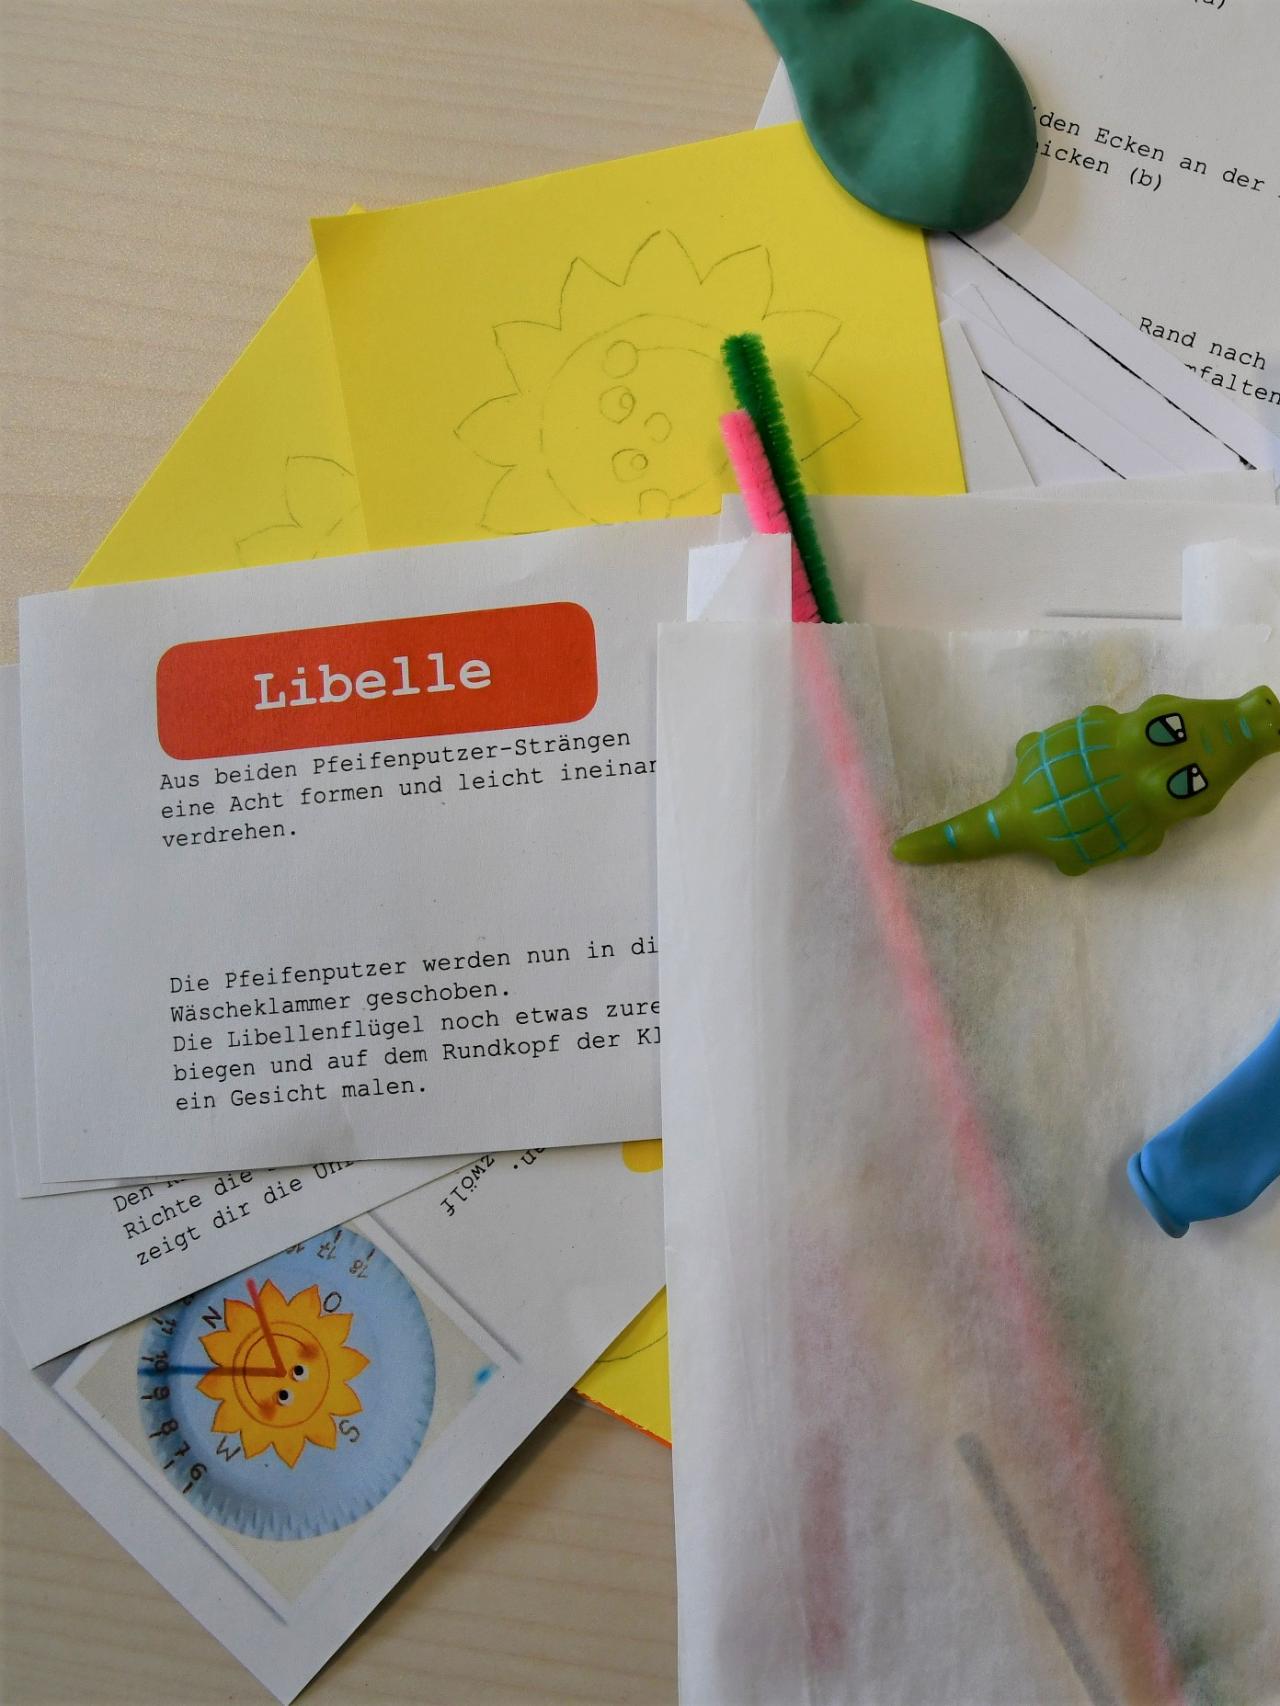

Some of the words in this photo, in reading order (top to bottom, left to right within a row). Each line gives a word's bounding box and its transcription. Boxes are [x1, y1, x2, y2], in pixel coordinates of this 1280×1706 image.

[1094, 128, 1164, 161] Ecken
[1180, 158, 1207, 175] an
[1223, 168, 1265, 191] der
[1130, 168, 1161, 191] (b)
[1139, 317, 1196, 348] Rand
[1209, 343, 1265, 370] nach
[254, 652, 491, 710] Libelle
[160, 774, 199, 790] Aus
[215, 763, 297, 784] beiden
[313, 733, 630, 774] Pfeifenputzer-Strängen
[162, 800, 214, 818] eine
[230, 792, 283, 812] Acht
[301, 786, 383, 805] formen
[399, 776, 442, 795] und
[459, 768, 543, 790] leicht
[162, 823, 295, 847] verdrehen.
[170, 974, 209, 993] Die
[225, 961, 406, 988] Pfeifenputzer
[422, 951, 510, 972] werden
[527, 948, 570, 963] nun
[587, 941, 615, 958] in
[631, 936, 658, 955] di
[170, 996, 350, 1022] Wäscheklammer
[367, 982, 508, 1011] geschoben.
[173, 1033, 212, 1052] Die
[228, 1015, 424, 1047] Libellenflügel
[441, 1010, 499, 1030] noch
[516, 1007, 588, 1024] etwas
[173, 1062, 255, 1082] biegen
[270, 1054, 312, 1073] und
[328, 1049, 367, 1069] auf
[385, 1047, 428, 1064] dem
[442, 1035, 560, 1060] Rundkopf
[577, 1032, 620, 1050] der
[176, 1092, 216, 1110] ein
[231, 1084, 327, 1106] Gesicht
[342, 1078, 425, 1098] malen.
[113, 1184, 154, 1212] Den
[123, 1194, 202, 1239] Richte
[214, 1172, 253, 1196] die
[440, 1155, 495, 1216] zwölf
[137, 1226, 201, 1266] zeigt
[213, 1201, 250, 1229] dir
[264, 1178, 303, 1204] die
[201, 1305, 222, 1329] N
[338, 1419, 360, 1443] S
